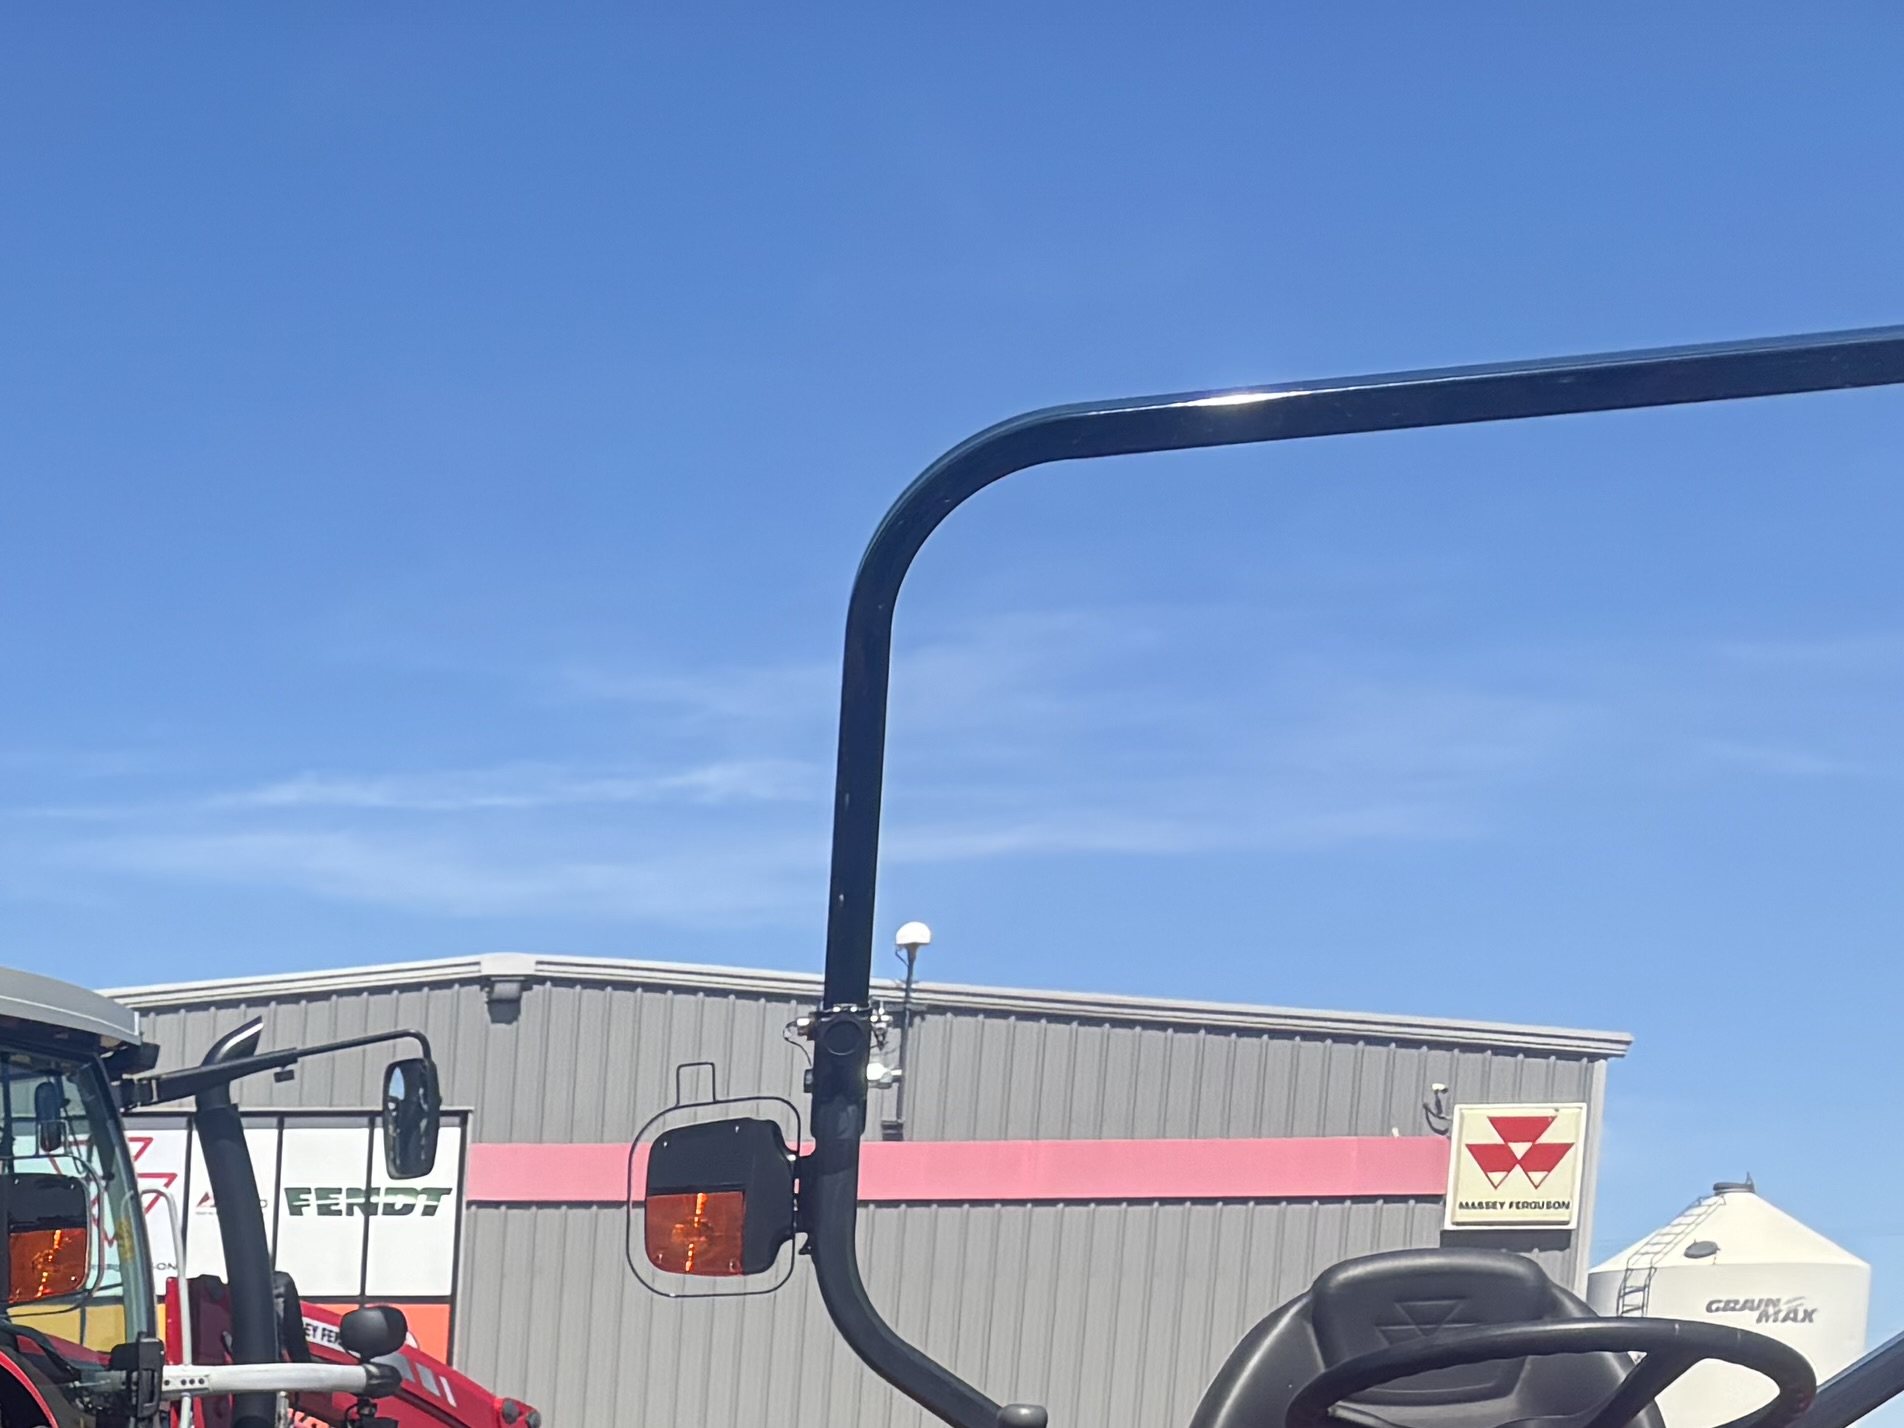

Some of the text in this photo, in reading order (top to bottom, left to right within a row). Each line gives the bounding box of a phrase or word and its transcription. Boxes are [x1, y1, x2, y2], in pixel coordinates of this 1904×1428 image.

[284, 1186, 452, 1217] FENDT
[1705, 1298, 1781, 1313] GRAIN
[1756, 1308, 1817, 1324] MAX
